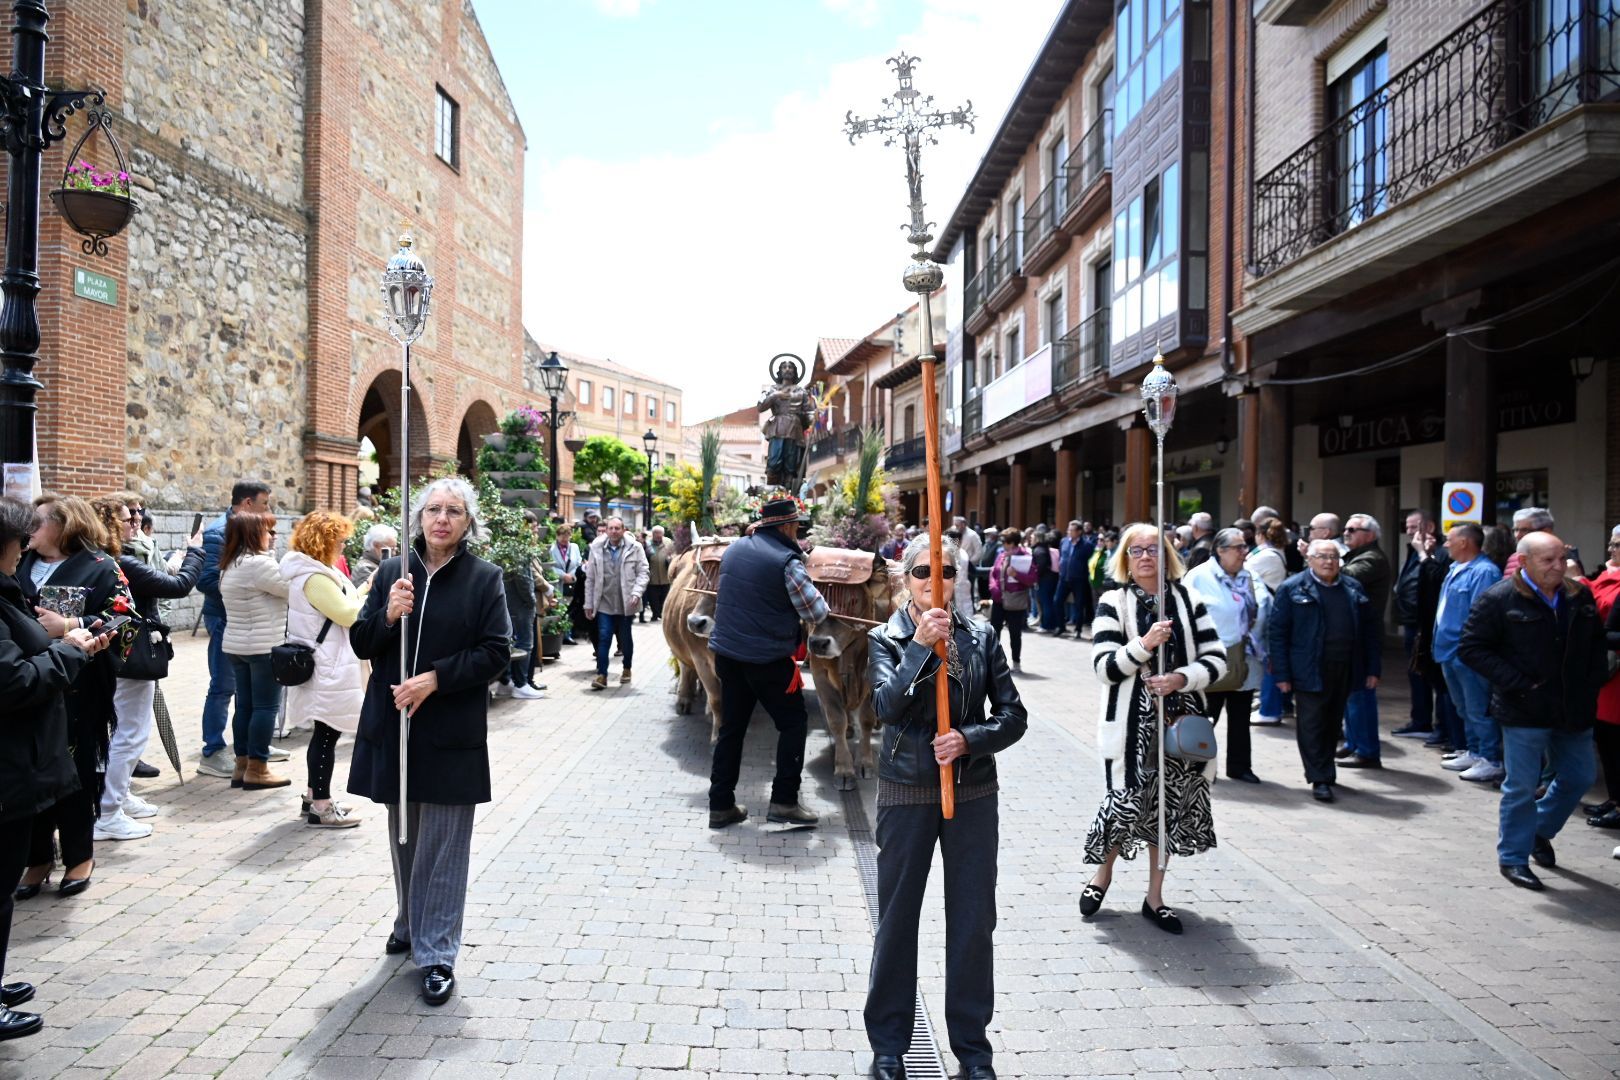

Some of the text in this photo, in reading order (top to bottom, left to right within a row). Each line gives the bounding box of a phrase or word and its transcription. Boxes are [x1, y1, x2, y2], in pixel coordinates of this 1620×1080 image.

[87, 276, 107, 289] PLAZA
[83, 286, 108, 300] MAYOR
[1324, 399, 1563, 453] OPTICA ITIVO
[1495, 478, 1534, 493] ONOS
